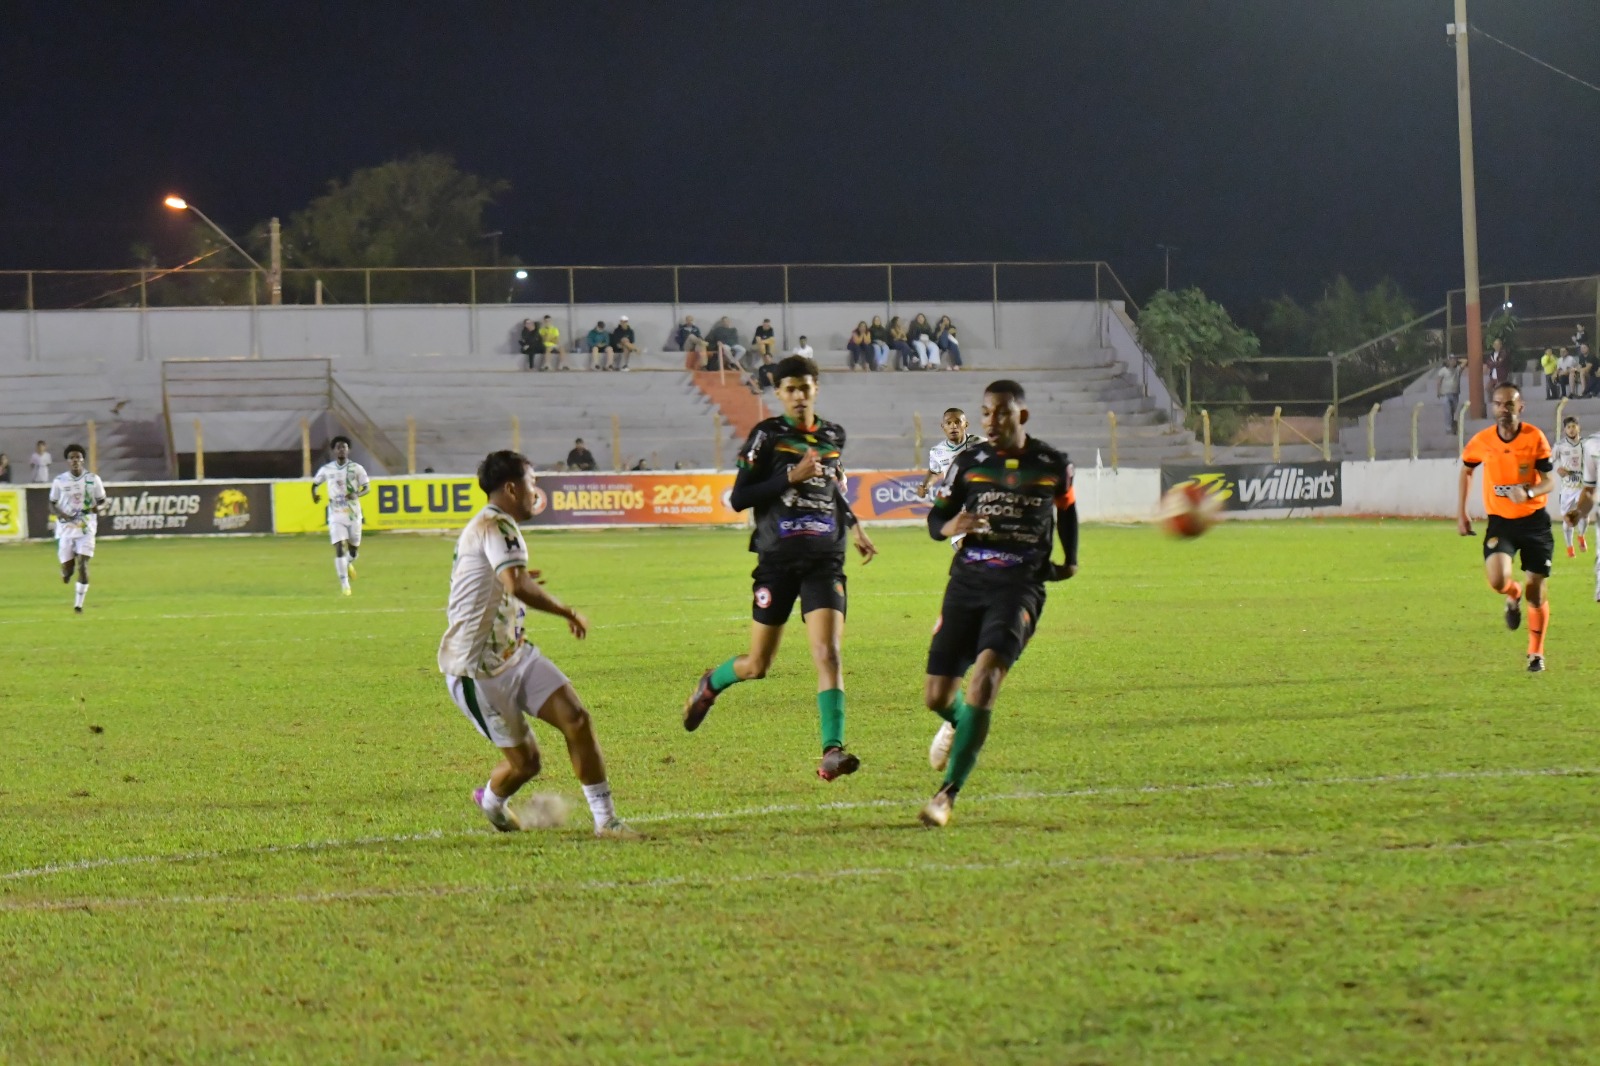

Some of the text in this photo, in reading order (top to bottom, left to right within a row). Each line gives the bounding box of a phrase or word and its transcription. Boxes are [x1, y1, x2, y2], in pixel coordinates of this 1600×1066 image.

[378, 483, 473, 514] BLUE
[653, 485, 714, 505] 2024
[1238, 468, 1335, 503] williarts
[552, 489, 645, 511] BARRETOS
